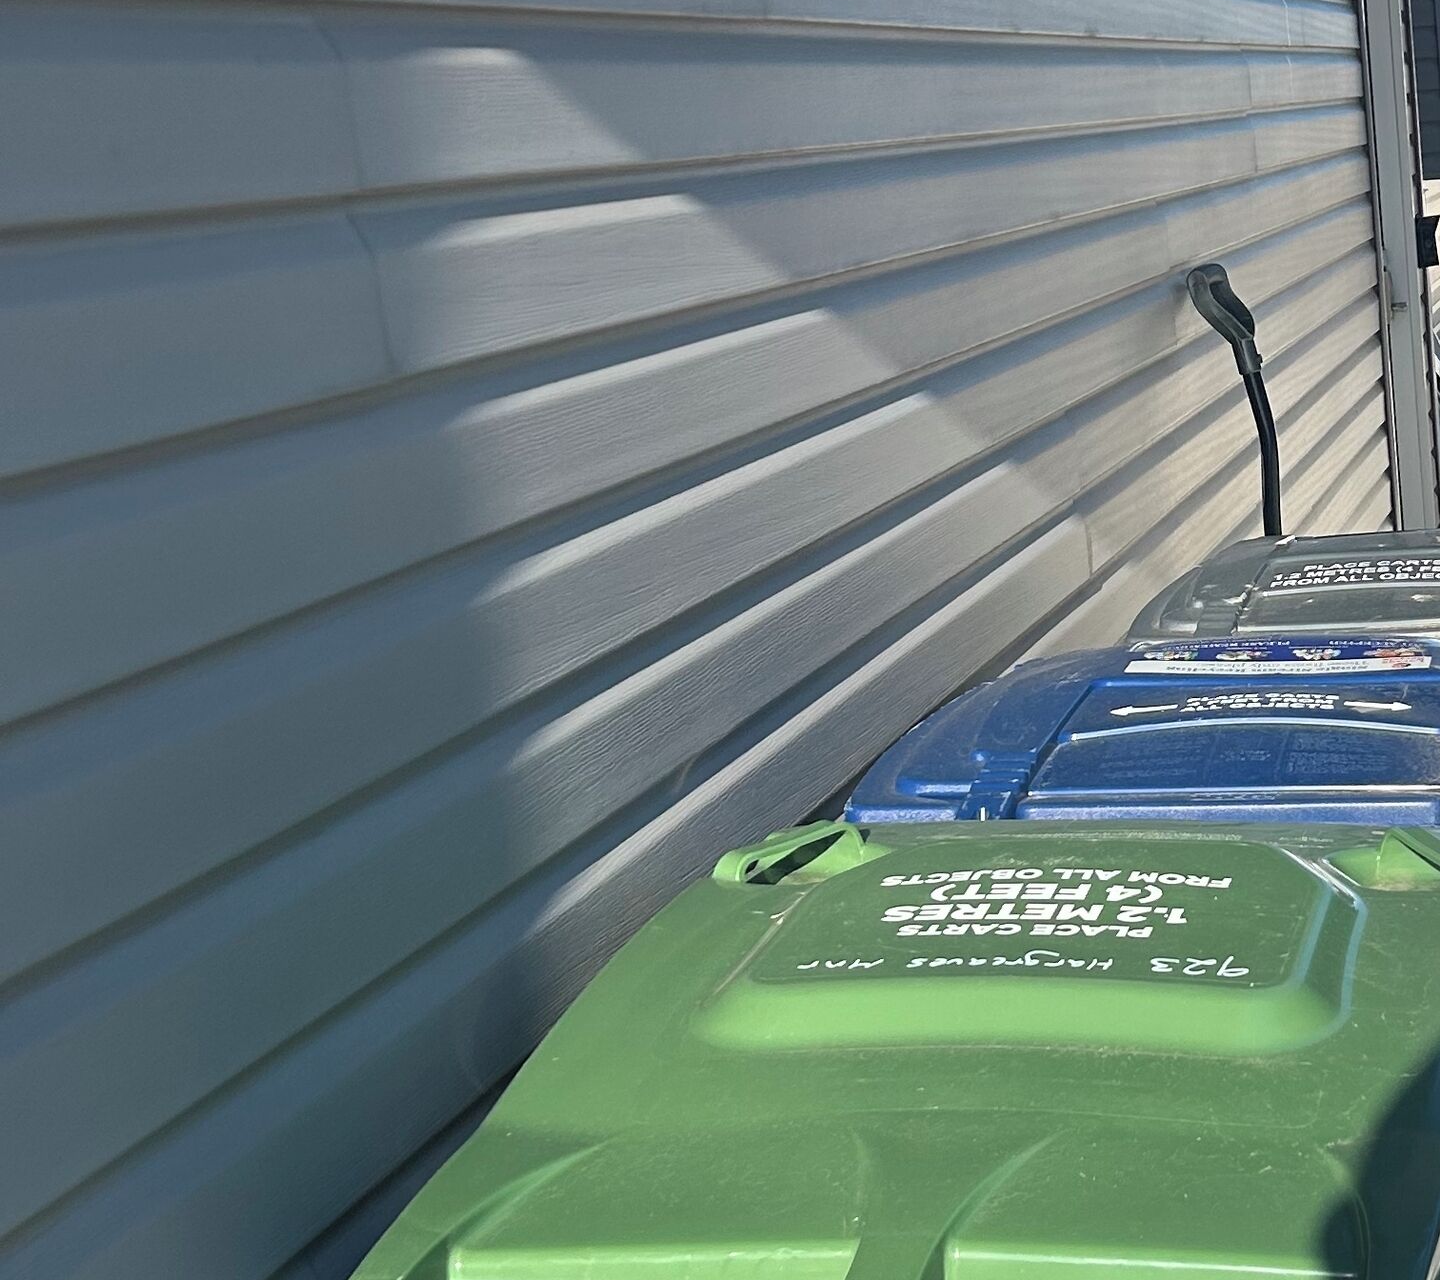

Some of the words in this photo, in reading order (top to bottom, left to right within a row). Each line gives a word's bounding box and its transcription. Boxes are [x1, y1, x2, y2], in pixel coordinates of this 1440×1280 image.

[1273, 572, 1303, 581] 1.2
[1305, 566, 1390, 578] METRES
[1303, 560, 1370, 572] PLACE
[1269, 577, 1331, 588] FROM
[1333, 572, 1374, 583] ALL
[1179, 704, 1223, 713] ALL
[1229, 702, 1335, 710] OBJECTS
[1269, 697, 1334, 705] FROM
[879, 868, 1044, 887] OBJECTS
[1052, 868, 1122, 881] ALL
[1127, 870, 1233, 889] FROM
[930, 883, 1092, 902] FEET)
[1105, 884, 1163, 904] (4
[880, 903, 1105, 922] METRES
[1116, 904, 1188, 924] 1.2
[896, 923, 1022, 936] CARTS
[1028, 923, 1154, 938] PLACE
[905, 949, 1114, 971] Hargreaves
[1149, 955, 1250, 977] 923
